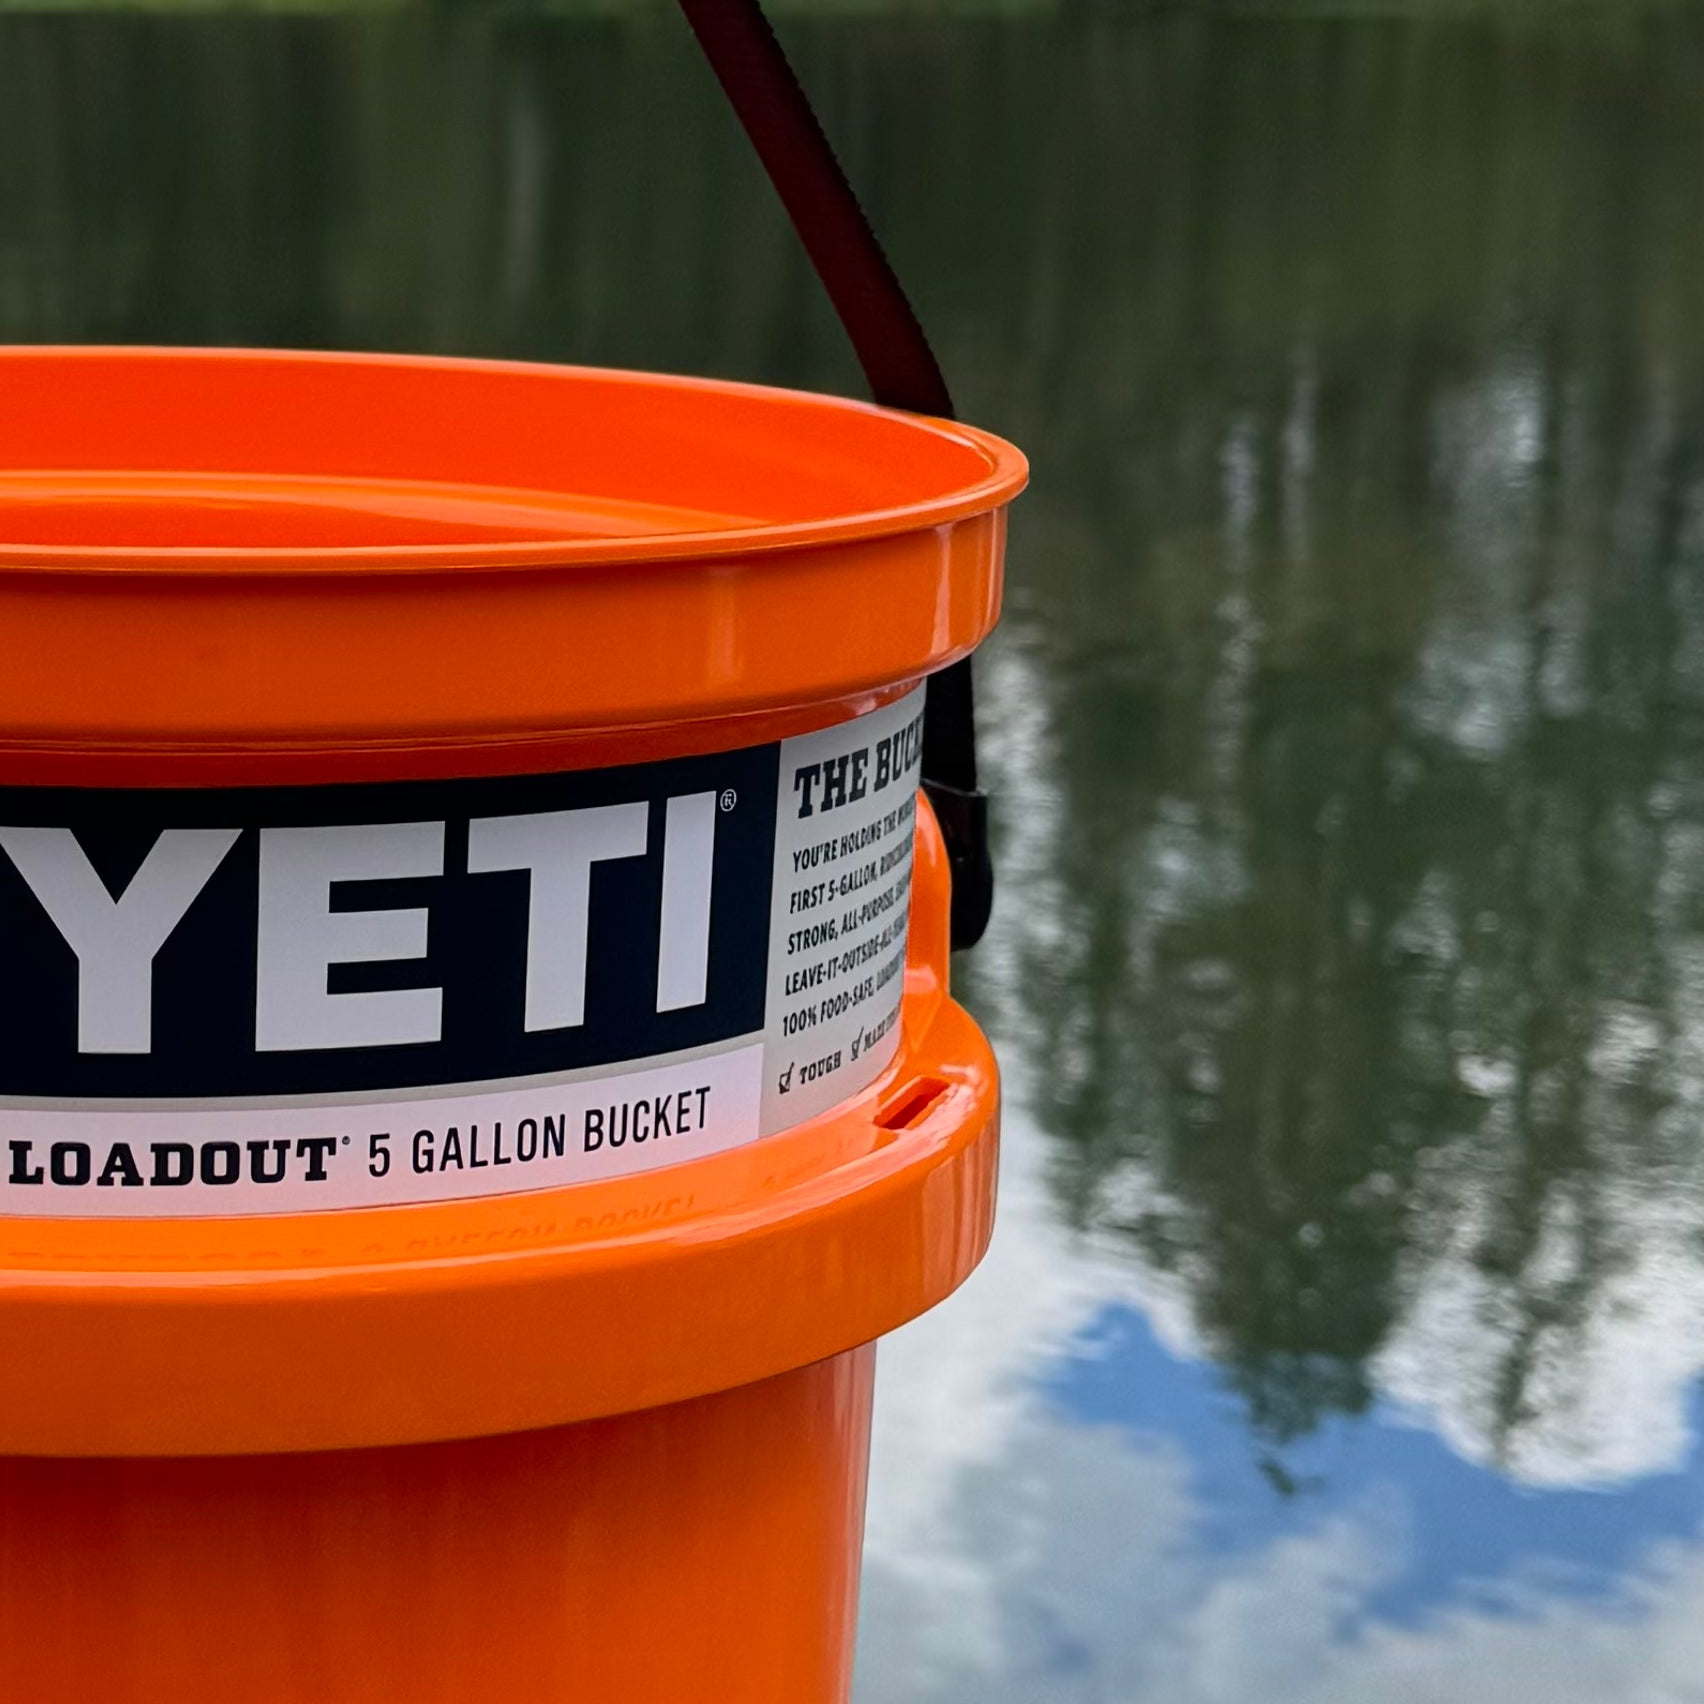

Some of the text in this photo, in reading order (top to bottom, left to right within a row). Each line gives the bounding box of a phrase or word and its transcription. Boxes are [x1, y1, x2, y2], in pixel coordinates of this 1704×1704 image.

[793, 747, 869, 819] THE
[792, 838, 838, 873] YOU'RE
[839, 819, 882, 858] HOLDING
[789, 883, 826, 914] FIRST
[787, 918, 839, 956] STRONG,
[782, 1004, 817, 1037] 100%
[799, 1050, 842, 1085] TOUGH
[368, 1133, 391, 1178] 5
[411, 1113, 566, 1174] GALLON
[583, 1085, 711, 1153] BUCKET
